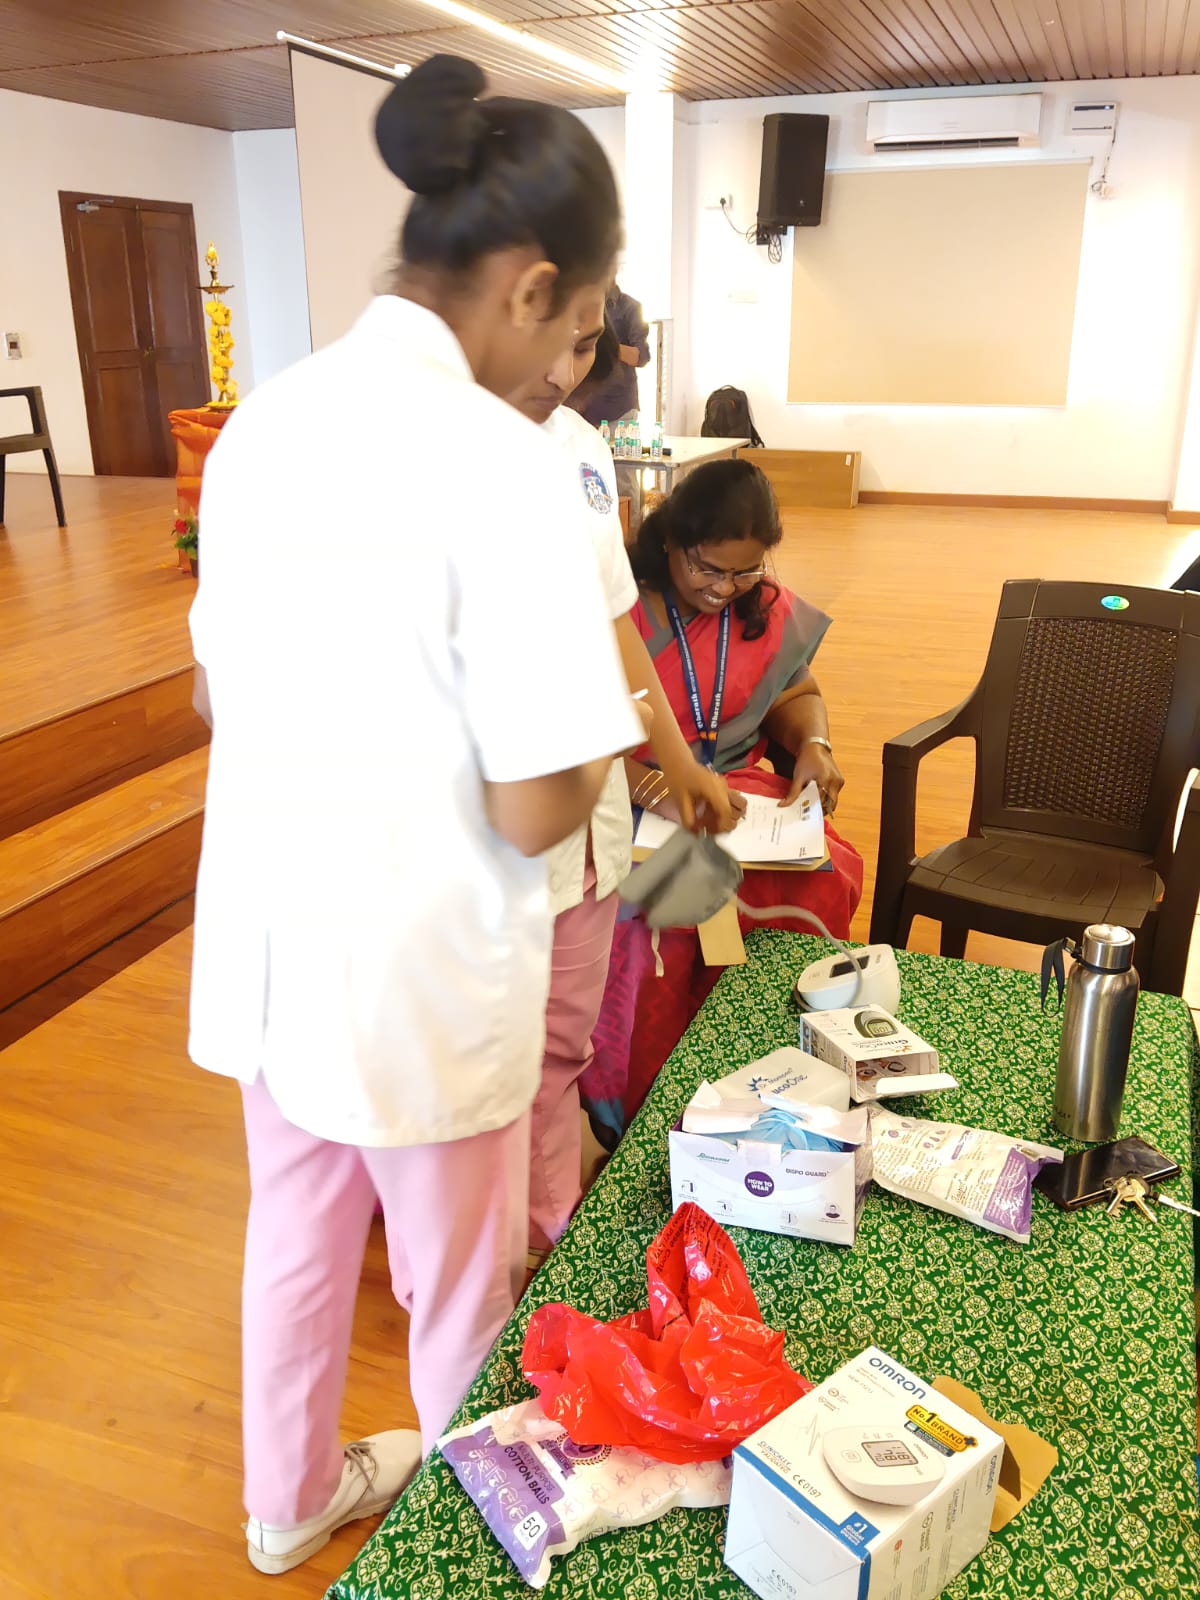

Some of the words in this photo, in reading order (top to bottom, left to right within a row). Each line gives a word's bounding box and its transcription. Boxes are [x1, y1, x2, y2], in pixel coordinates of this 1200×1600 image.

[869, 1357, 926, 1400] OMRON
[931, 1421, 964, 1445] BRAND
[504, 1446, 534, 1482] COTTON
[528, 1480, 550, 1505] BALLS
[522, 1516, 541, 1538] 50
